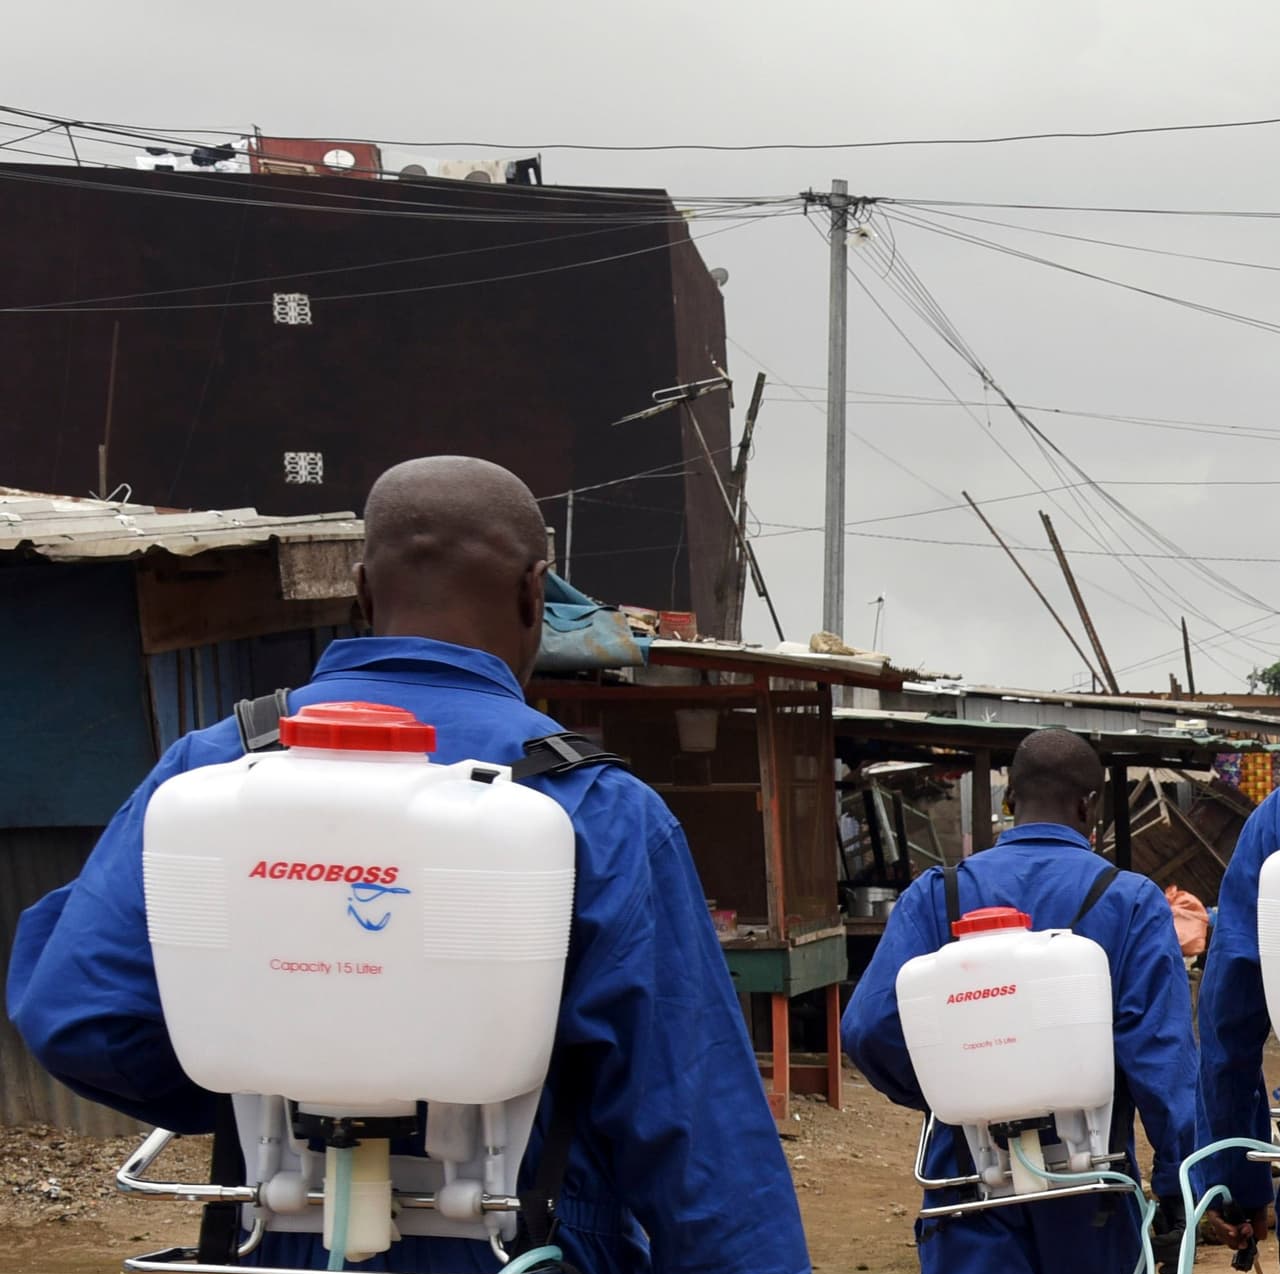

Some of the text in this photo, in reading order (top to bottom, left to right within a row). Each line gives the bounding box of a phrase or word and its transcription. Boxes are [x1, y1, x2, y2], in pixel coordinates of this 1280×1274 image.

[248, 861, 399, 884] AGROBOSS
[269, 958, 383, 975] Capacity 15 Liter
[947, 984, 1016, 1004] AGROBOSS
